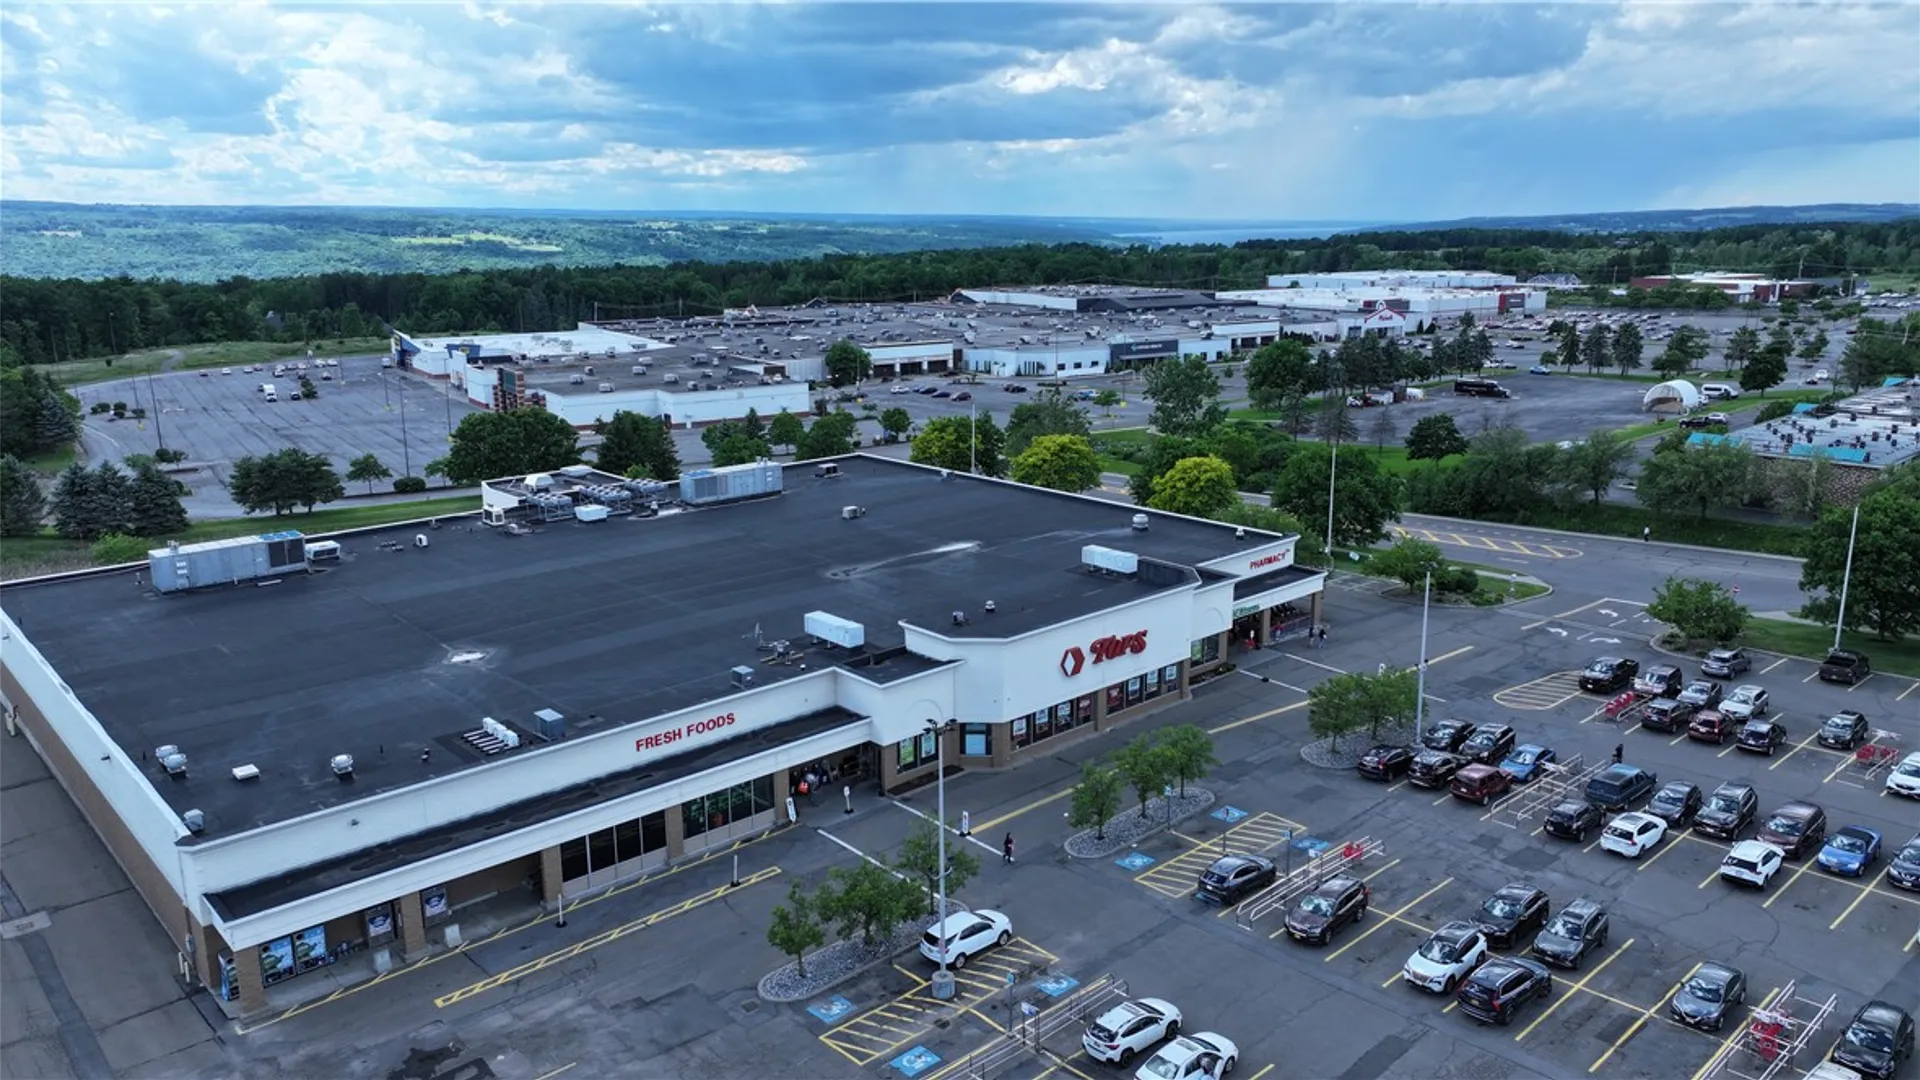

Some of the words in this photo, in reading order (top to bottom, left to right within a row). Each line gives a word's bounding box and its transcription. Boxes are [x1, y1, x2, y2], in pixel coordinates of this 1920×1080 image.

[1250, 552, 1286, 569] PHARMACY
[635, 728, 682, 751] FRESH
[687, 714, 735, 735] FOODS
